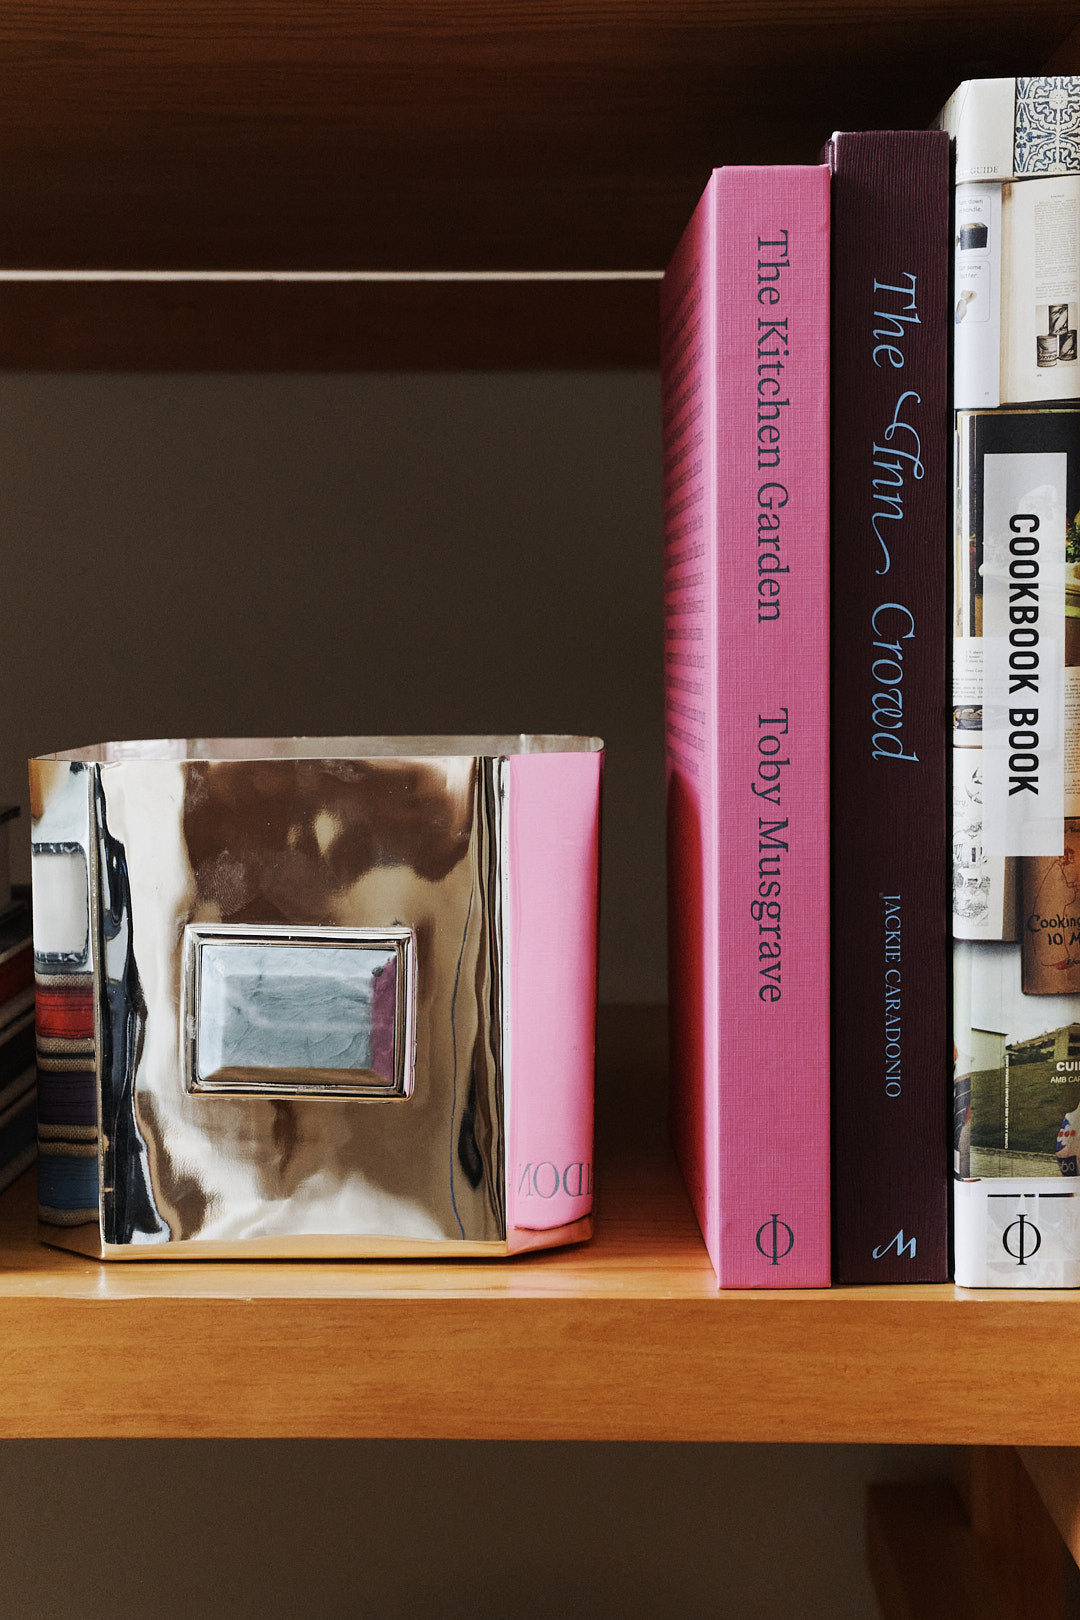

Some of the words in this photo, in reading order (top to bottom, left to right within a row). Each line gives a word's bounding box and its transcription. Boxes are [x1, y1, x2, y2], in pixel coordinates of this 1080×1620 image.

[757, 229, 791, 306] The
[872, 271, 922, 369] The
[757, 316, 790, 471] Kitchen
[871, 390, 925, 575] Inn
[757, 482, 791, 624] Garden
[1008, 513, 1040, 695] COOKBOOK
[871, 602, 920, 762] Crowd
[750, 707, 791, 806] Toby
[1008, 708, 1040, 797] BOOK
[750, 816, 790, 1003] Musgrave
[882, 894, 902, 963] JACKIE
[1047, 932, 1063, 946] 10
[884, 968, 902, 1098] CARADONIO
[1050, 1076, 1067, 1084] AMB
[1056, 1061, 1080, 1072] CUI
